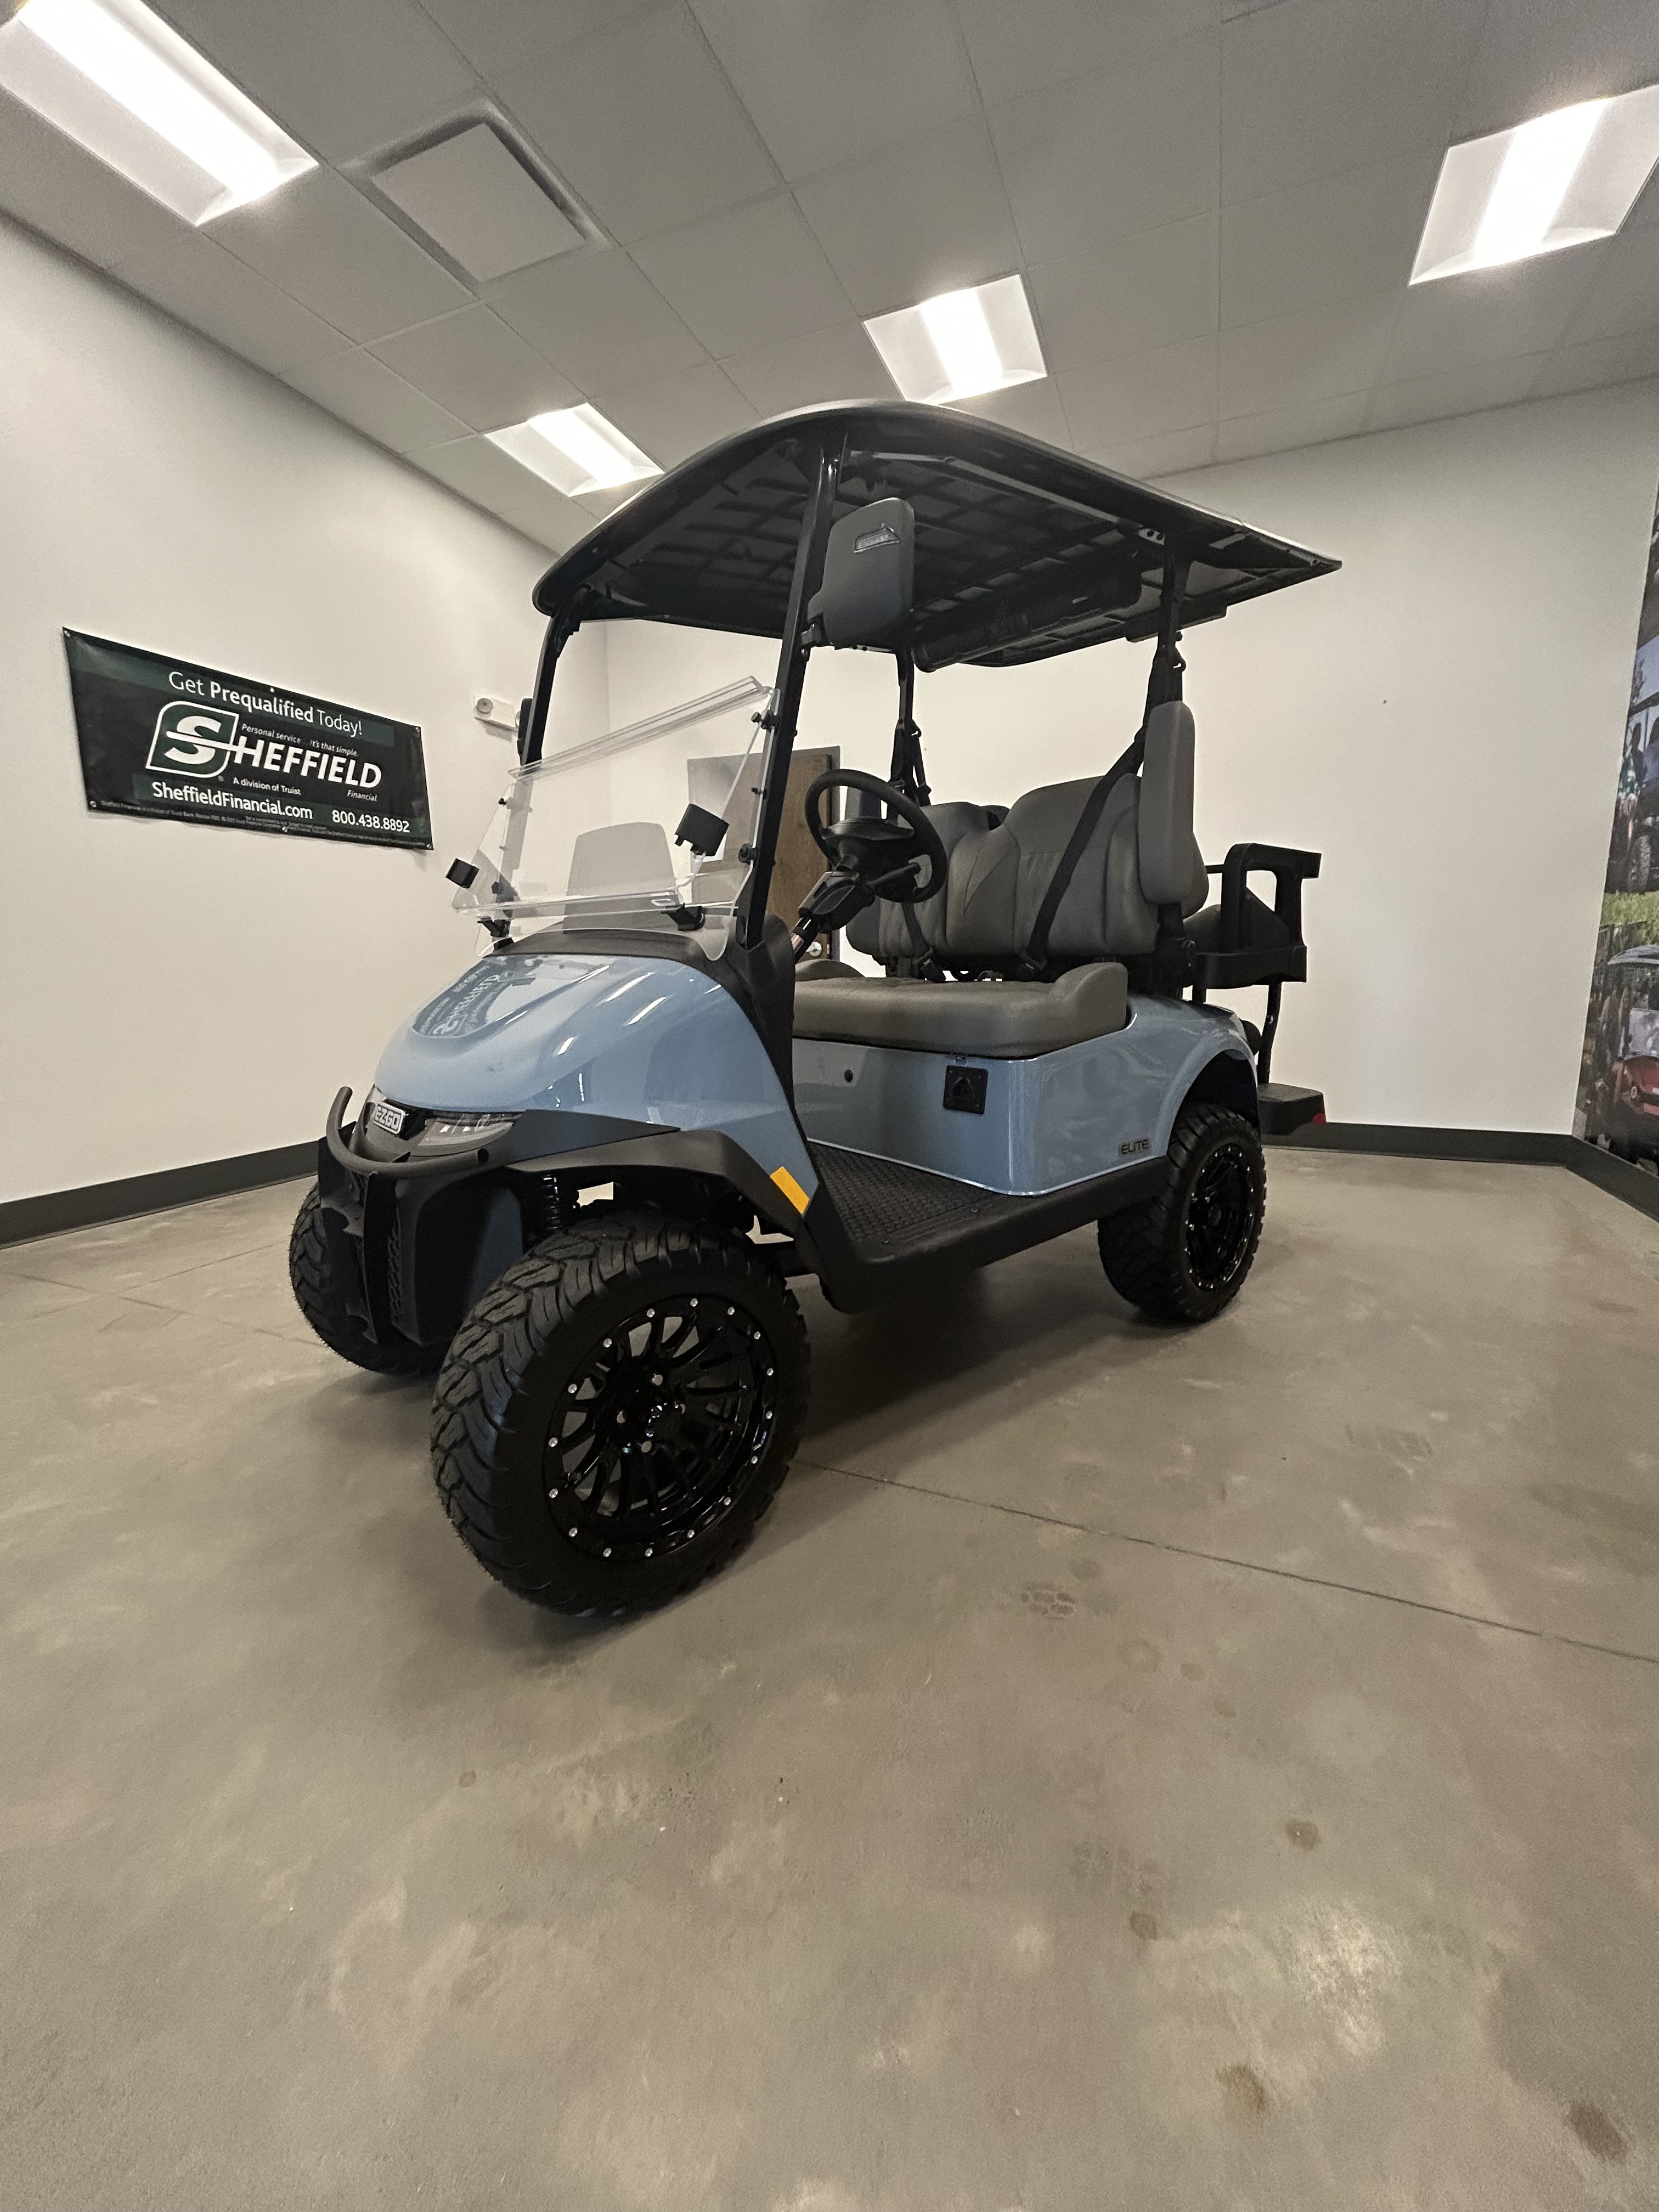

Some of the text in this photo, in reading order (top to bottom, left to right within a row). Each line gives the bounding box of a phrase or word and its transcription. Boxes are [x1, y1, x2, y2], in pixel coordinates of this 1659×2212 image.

[168, 671, 363, 738] Get Prequalified Today!
[241, 723, 275, 738] Personal
[321, 742, 335, 752] that
[163, 715, 382, 789] SHEFFIELD
[233, 777, 302, 795] A division of Truist
[347, 789, 378, 802] Financial
[151, 781, 313, 820] SheffieldFinancial.com
[331, 809, 410, 833] 800.438.8892
[1121, 1138, 1149, 1155] ELITE
